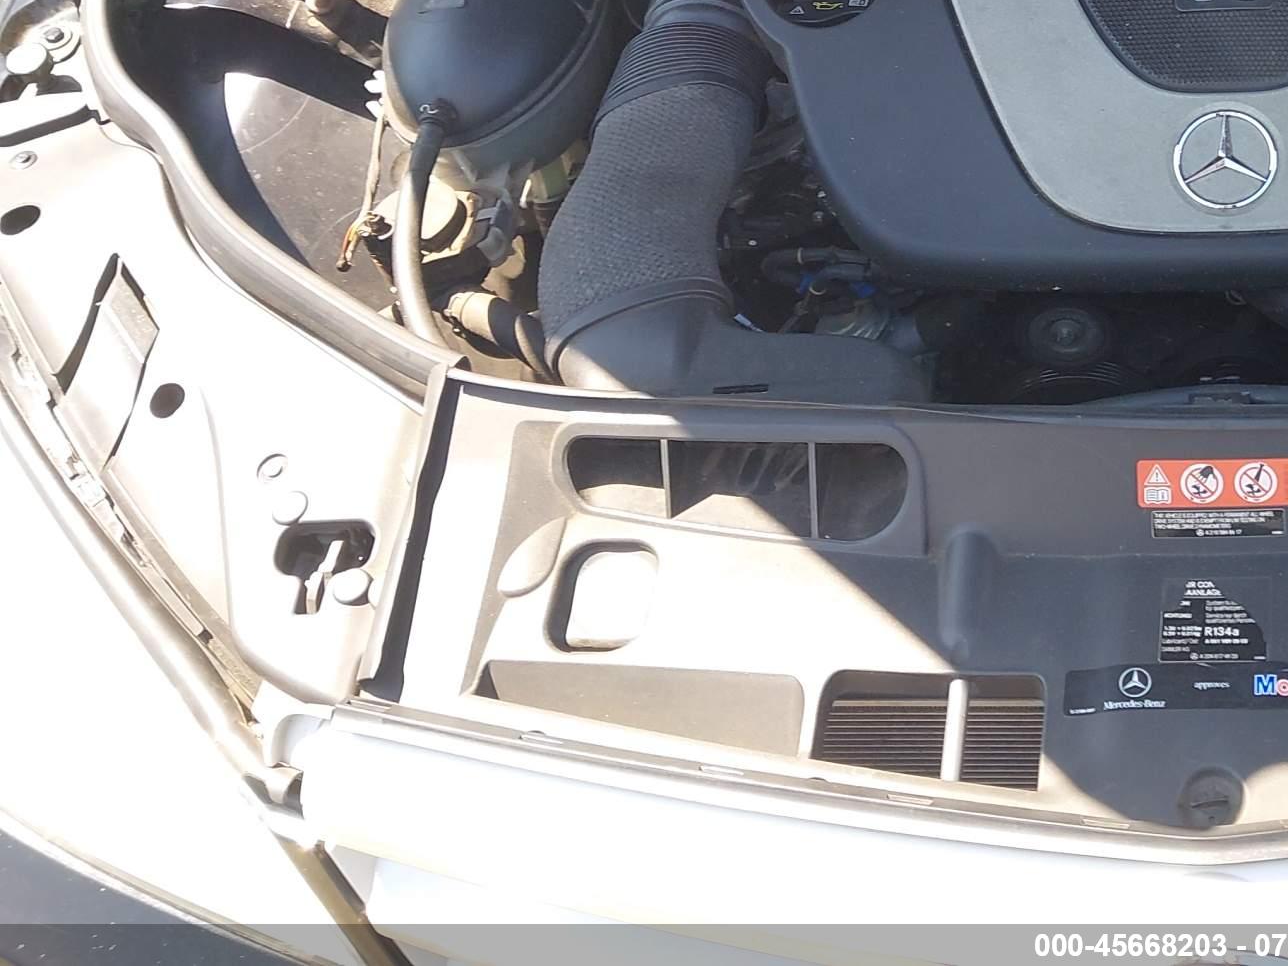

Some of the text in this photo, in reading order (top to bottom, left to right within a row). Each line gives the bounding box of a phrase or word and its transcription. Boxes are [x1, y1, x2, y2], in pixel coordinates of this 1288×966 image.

[1204, 627, 1240, 636] R134a
[1193, 682, 1231, 691] approves
[1103, 699, 1166, 711] Mercedes-Benz
